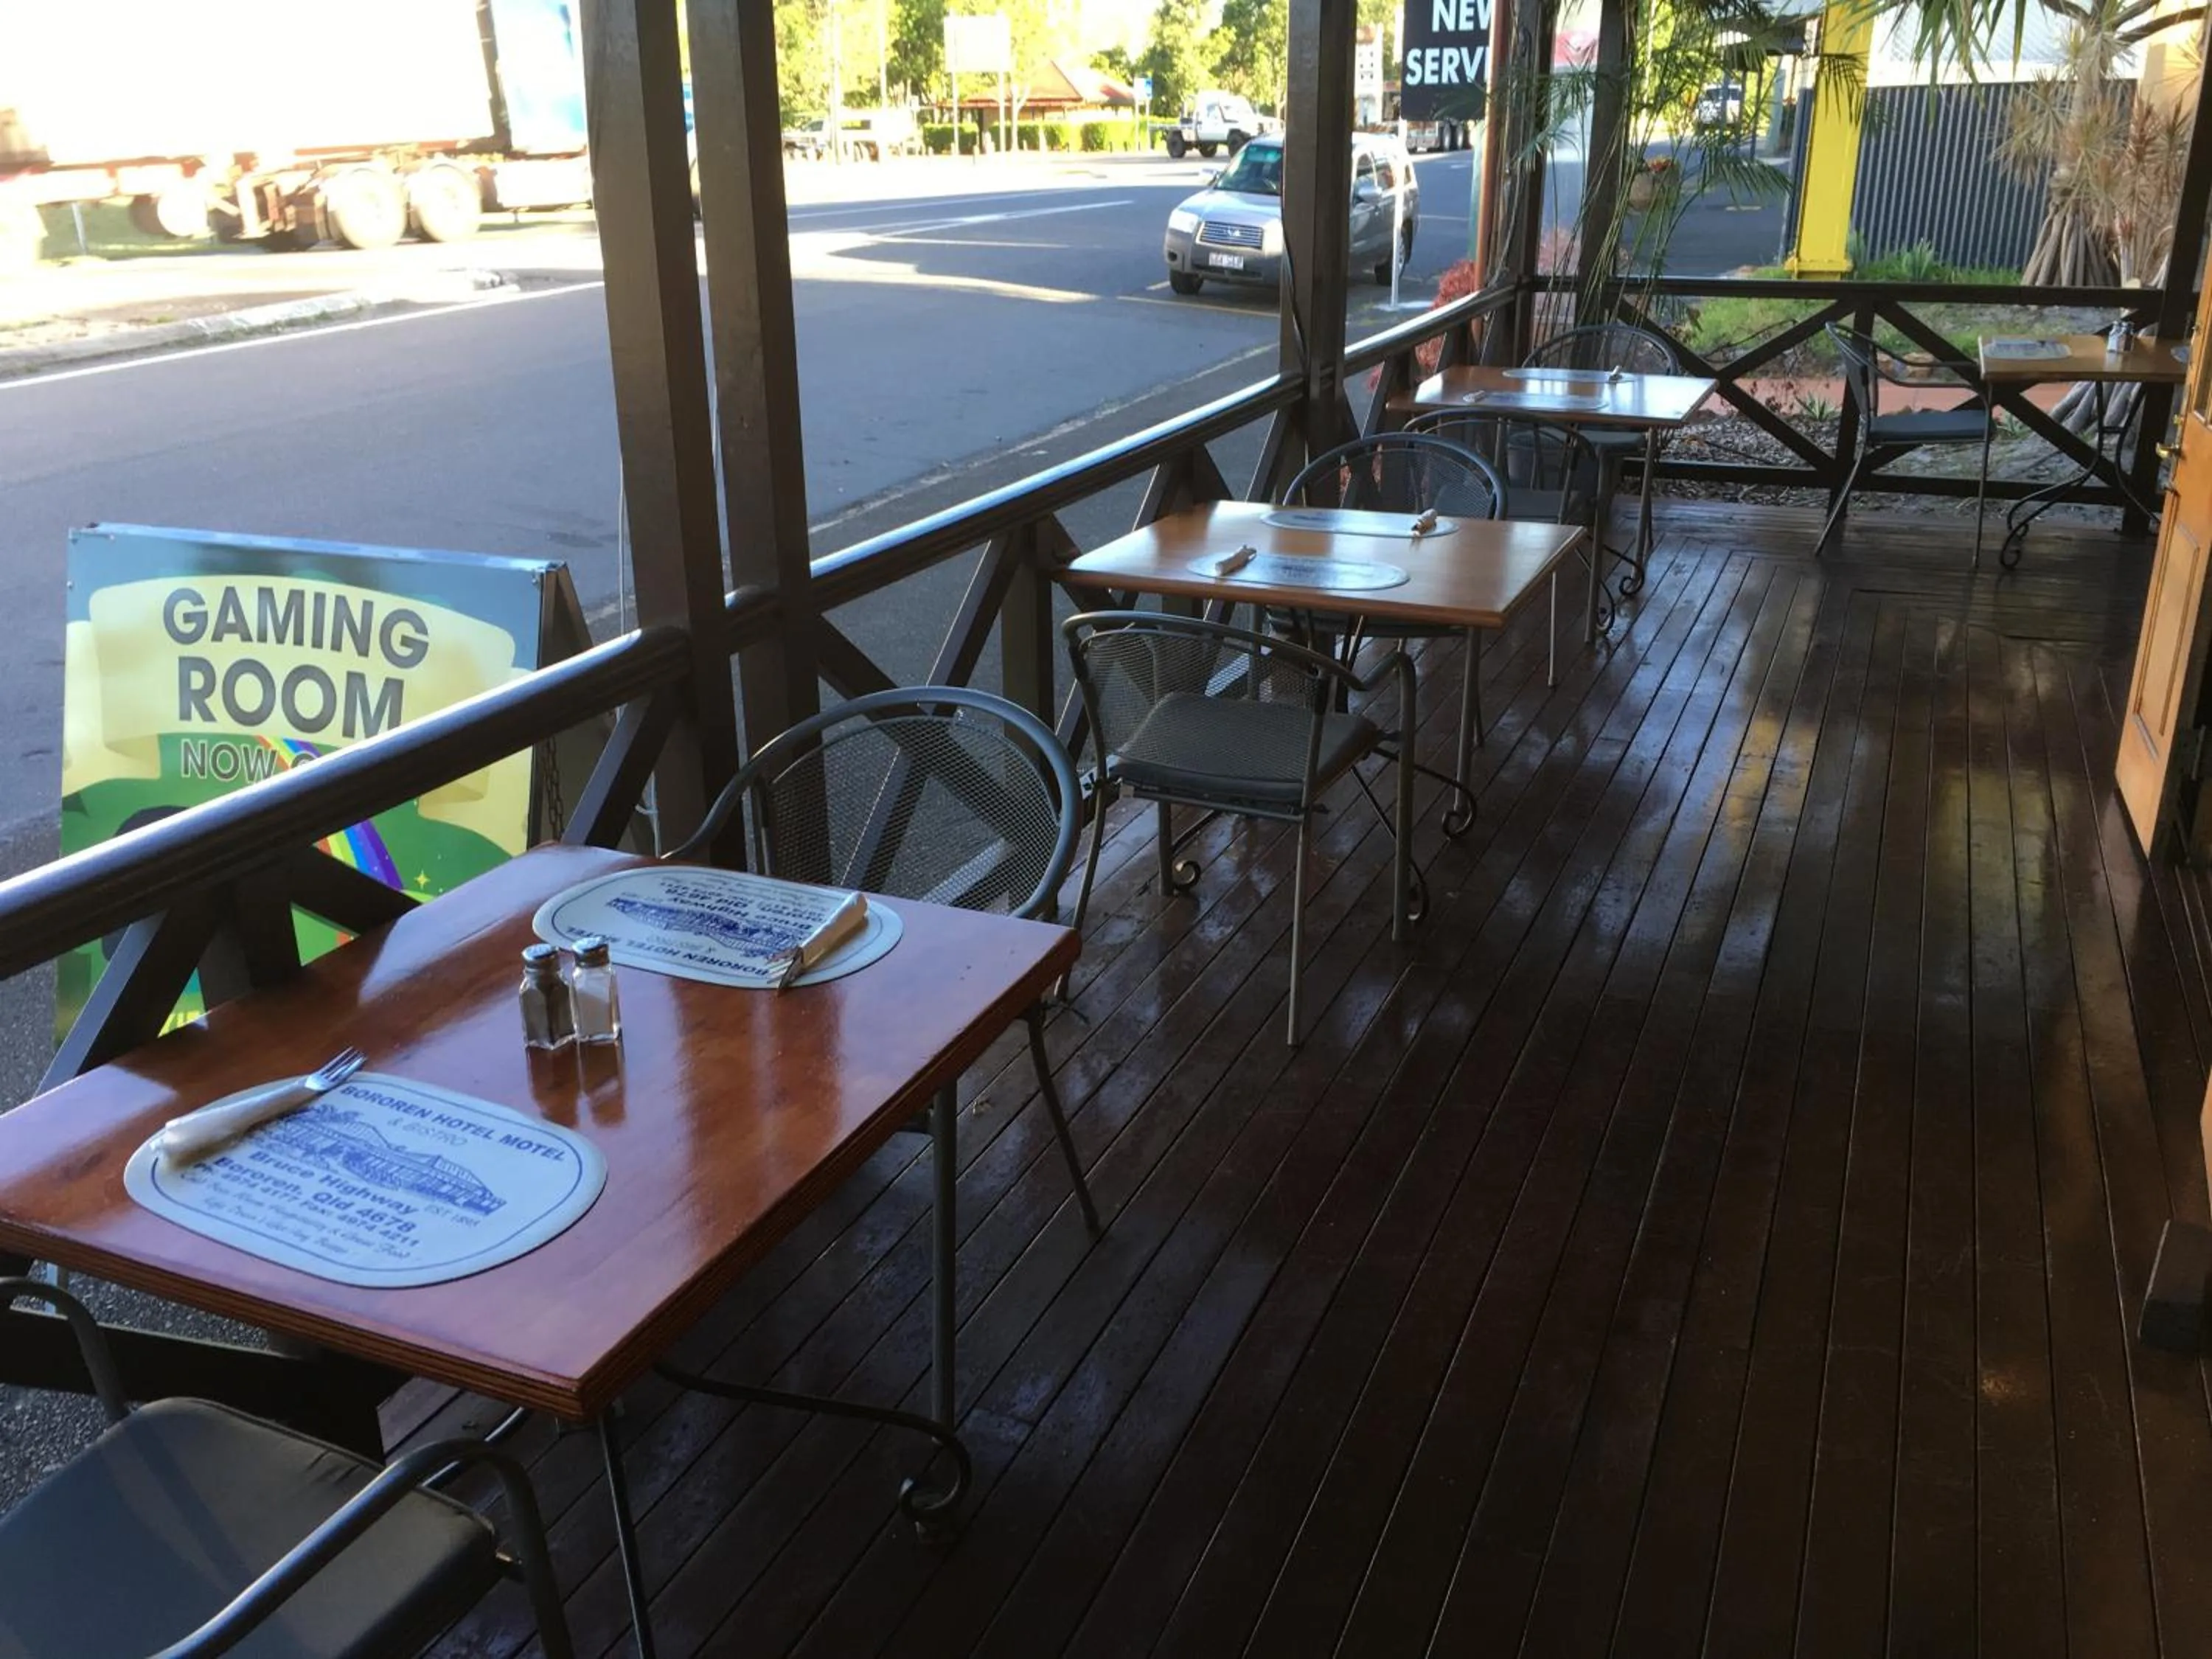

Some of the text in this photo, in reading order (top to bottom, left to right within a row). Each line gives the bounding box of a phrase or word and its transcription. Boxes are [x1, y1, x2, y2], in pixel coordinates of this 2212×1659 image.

[163, 586, 429, 669] GAMING
[178, 655, 405, 739] ROOM
[181, 738, 279, 784] NOW
[340, 1085, 568, 1163] BOROREN HOTEL MOTEL
[248, 1150, 420, 1215] Bruce Highway
[312, 1192, 355, 1211] Qld
[355, 1208, 417, 1234] 4678
